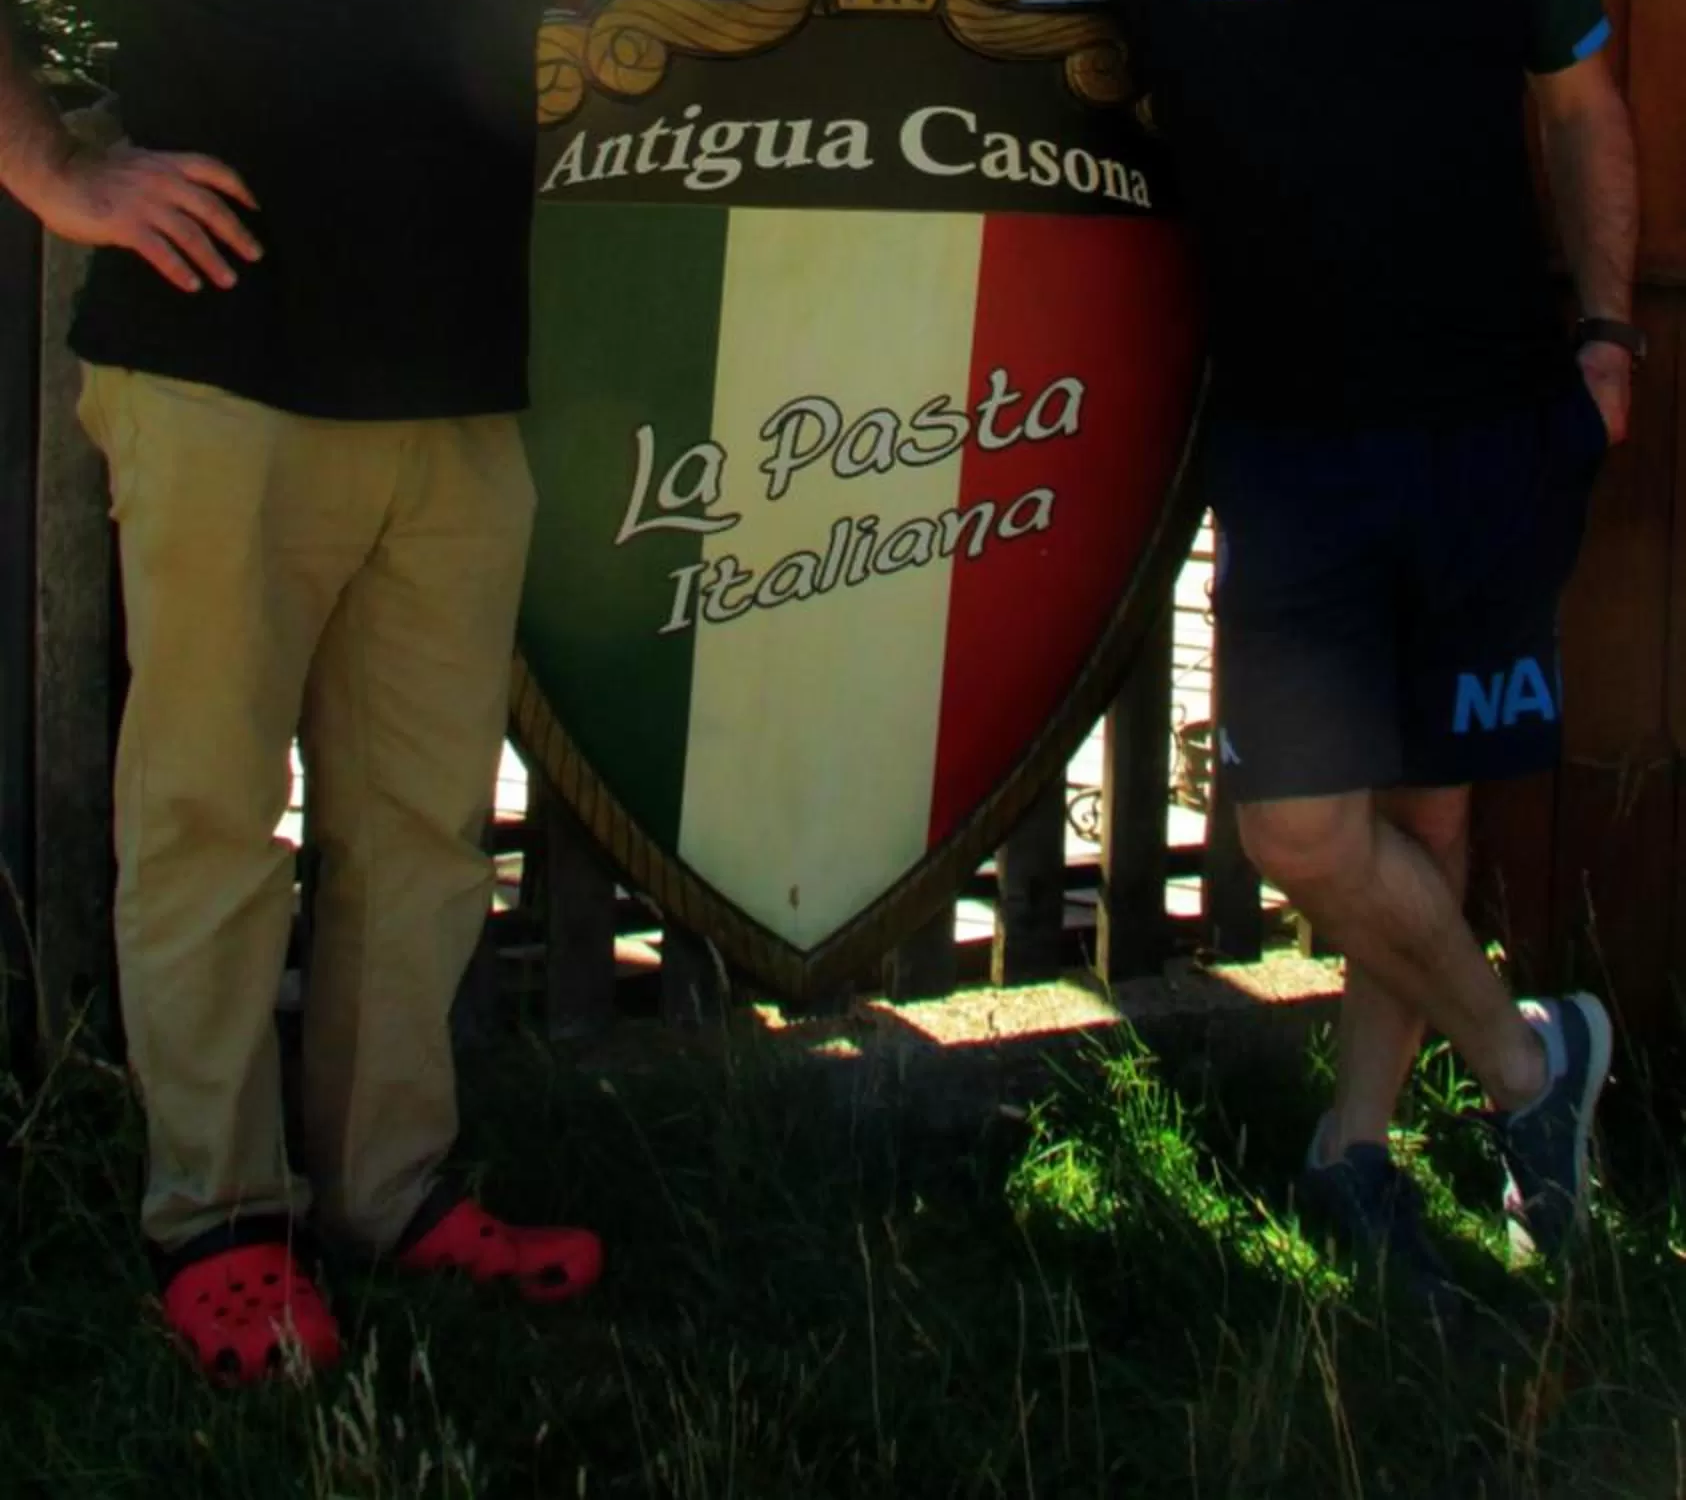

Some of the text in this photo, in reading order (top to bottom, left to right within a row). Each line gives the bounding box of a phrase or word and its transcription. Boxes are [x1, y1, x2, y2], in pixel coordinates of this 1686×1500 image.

[540, 103, 1152, 208] Antigua Casona
[613, 368, 1086, 546] La Pasta
[657, 486, 1056, 635] Italiana
[1451, 655, 1556, 734] NA
